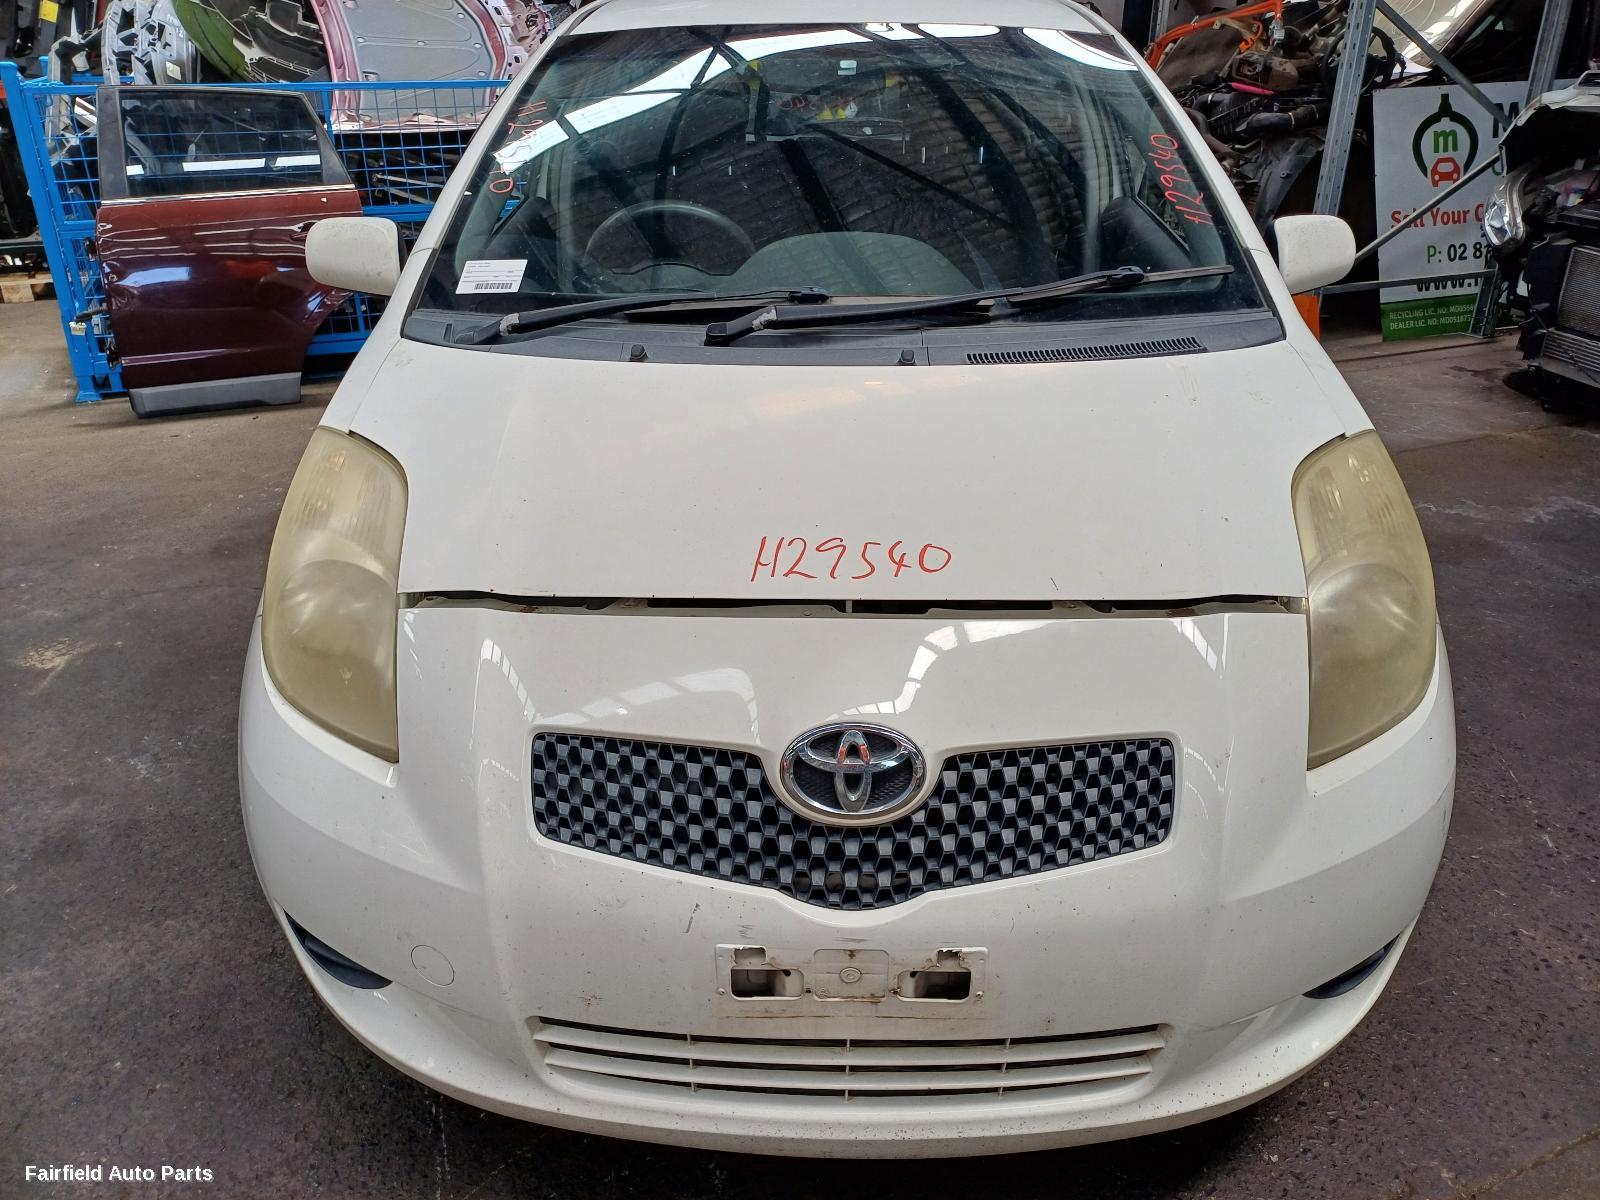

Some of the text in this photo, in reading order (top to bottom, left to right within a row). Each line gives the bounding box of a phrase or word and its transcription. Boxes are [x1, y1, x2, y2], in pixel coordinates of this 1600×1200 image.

[1147, 134, 1214, 225] H29540
[1429, 207, 1470, 227] Your
[1447, 243, 1468, 263] 02
[1472, 241, 1489, 260] 8
[1389, 308, 1424, 320] RECYCLING
[1390, 319, 1414, 330] DEALER
[750, 536, 952, 582] H29540
